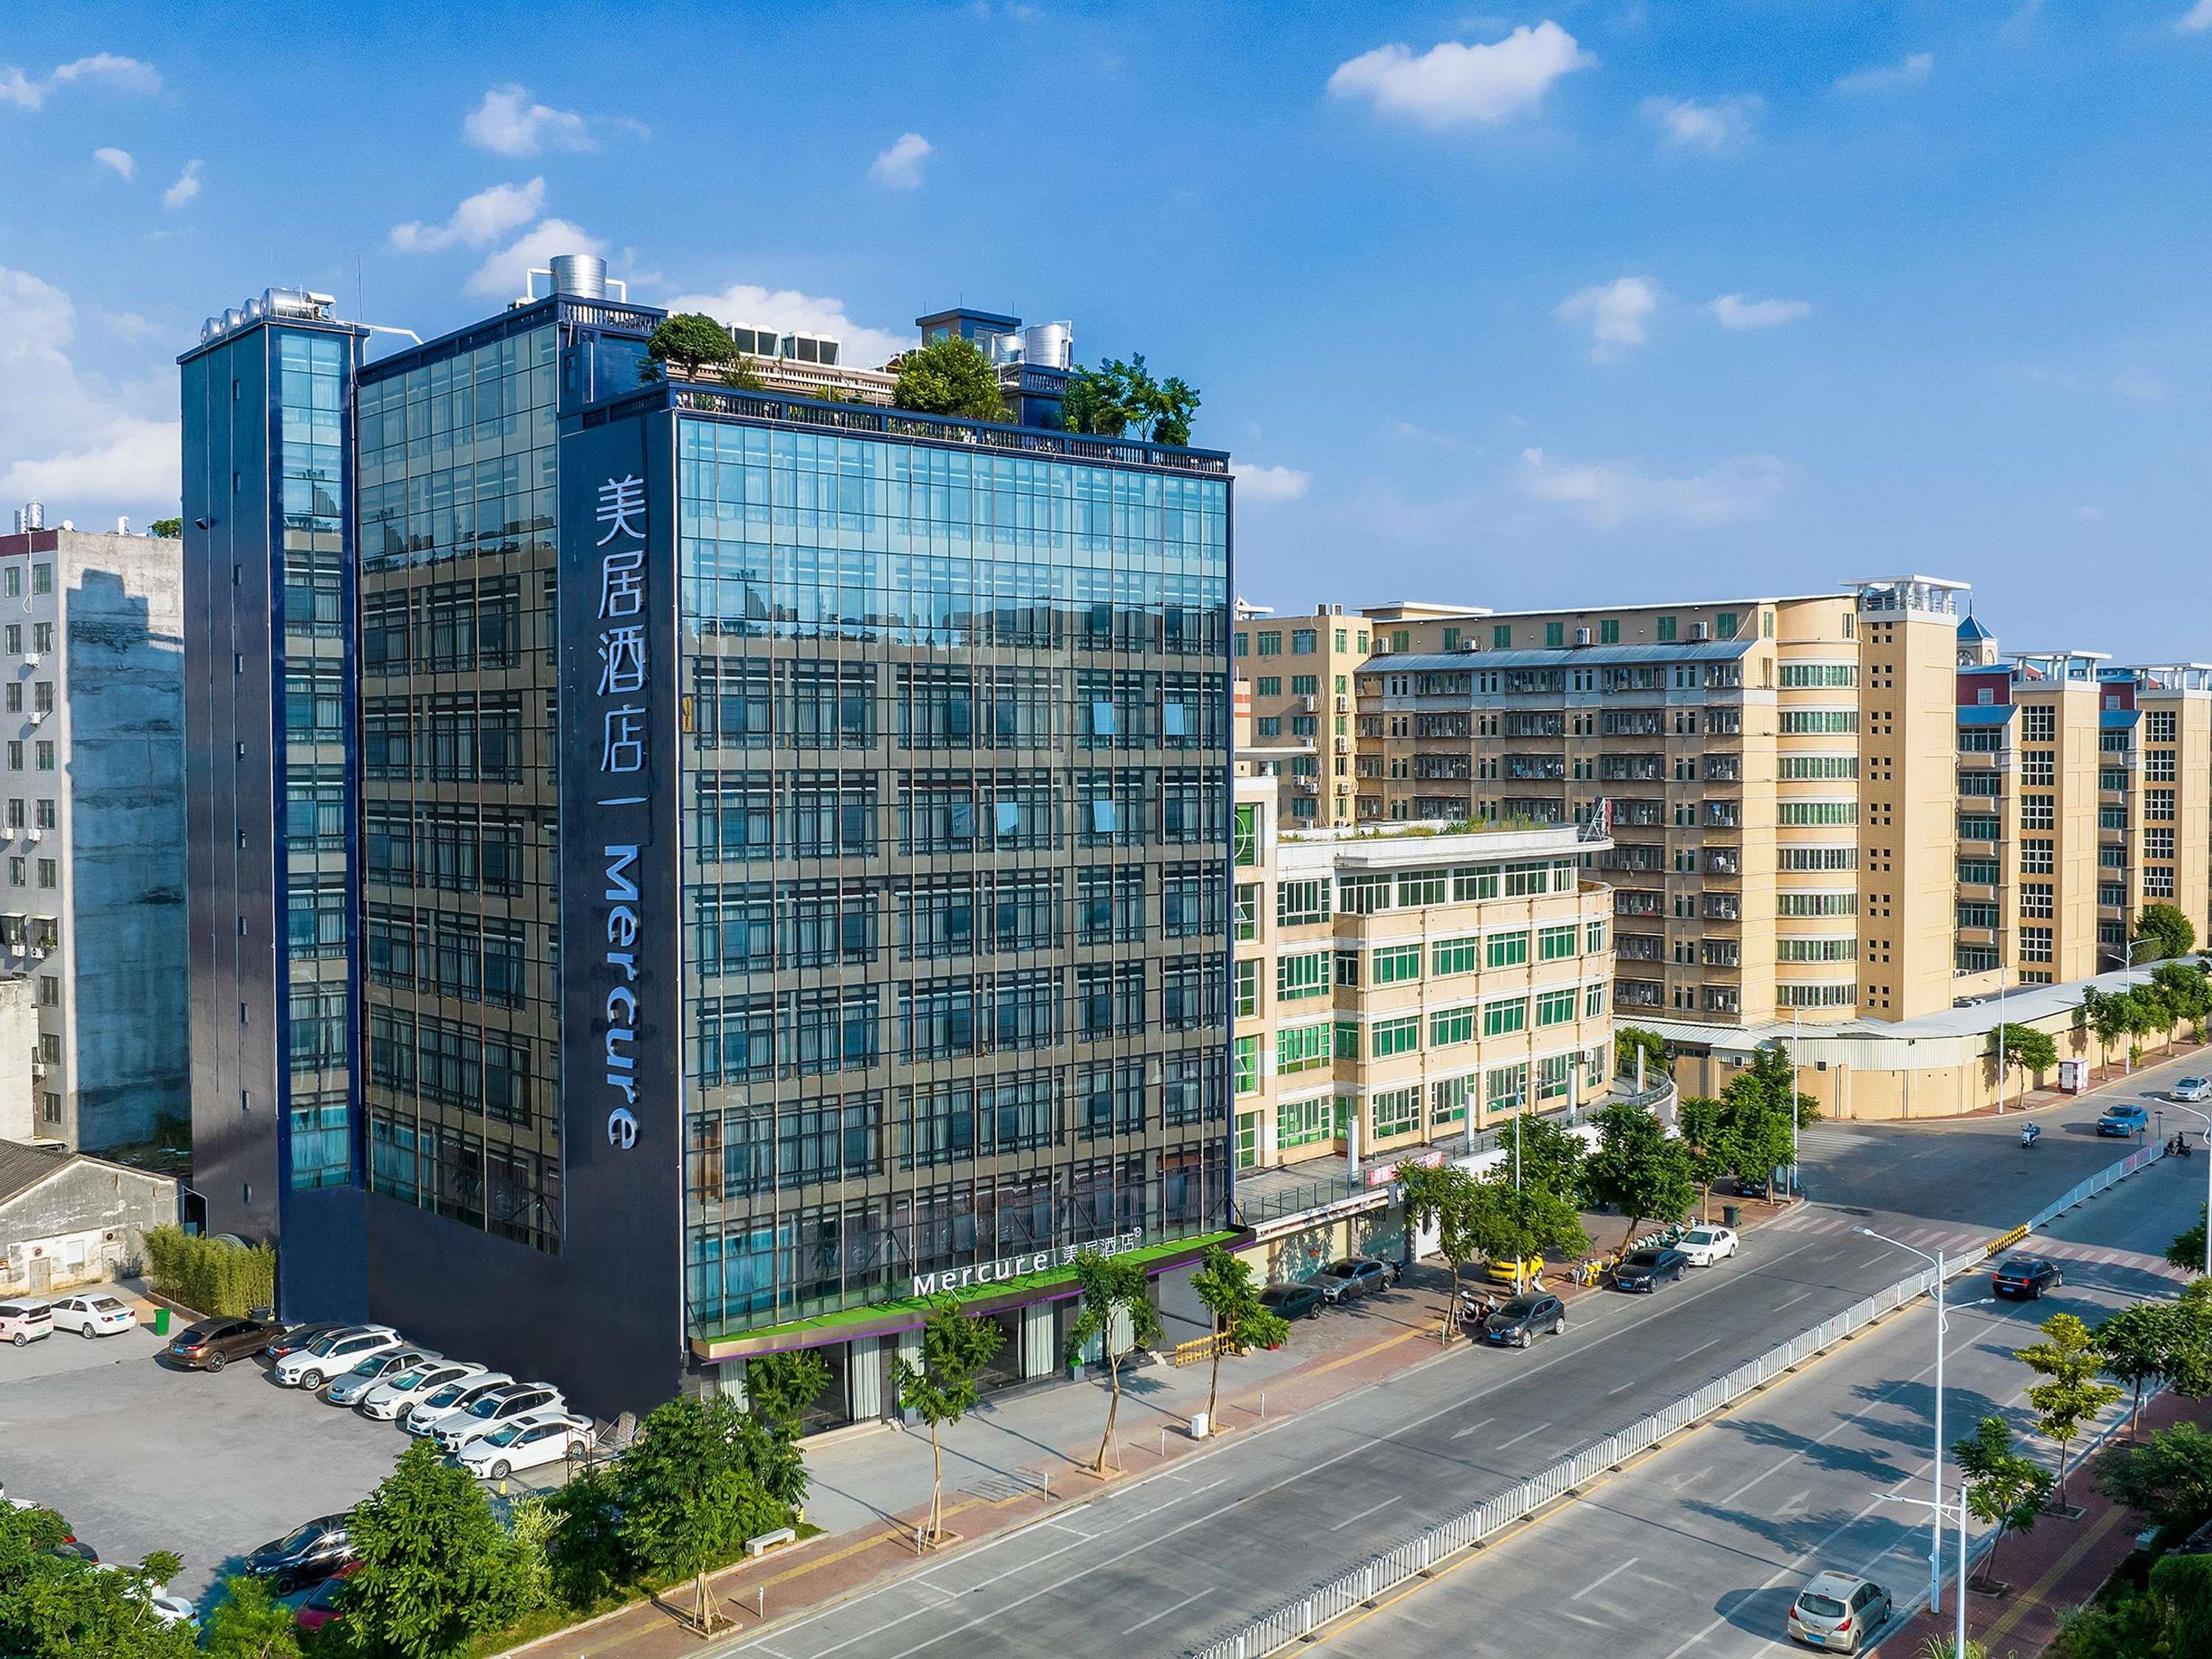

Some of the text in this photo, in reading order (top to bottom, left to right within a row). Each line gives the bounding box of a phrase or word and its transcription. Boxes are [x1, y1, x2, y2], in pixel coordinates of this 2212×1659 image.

[596, 473, 647, 772] 美居酒店
[605, 844, 639, 1150] Mercure
[914, 1252, 1048, 1298] Mercure
